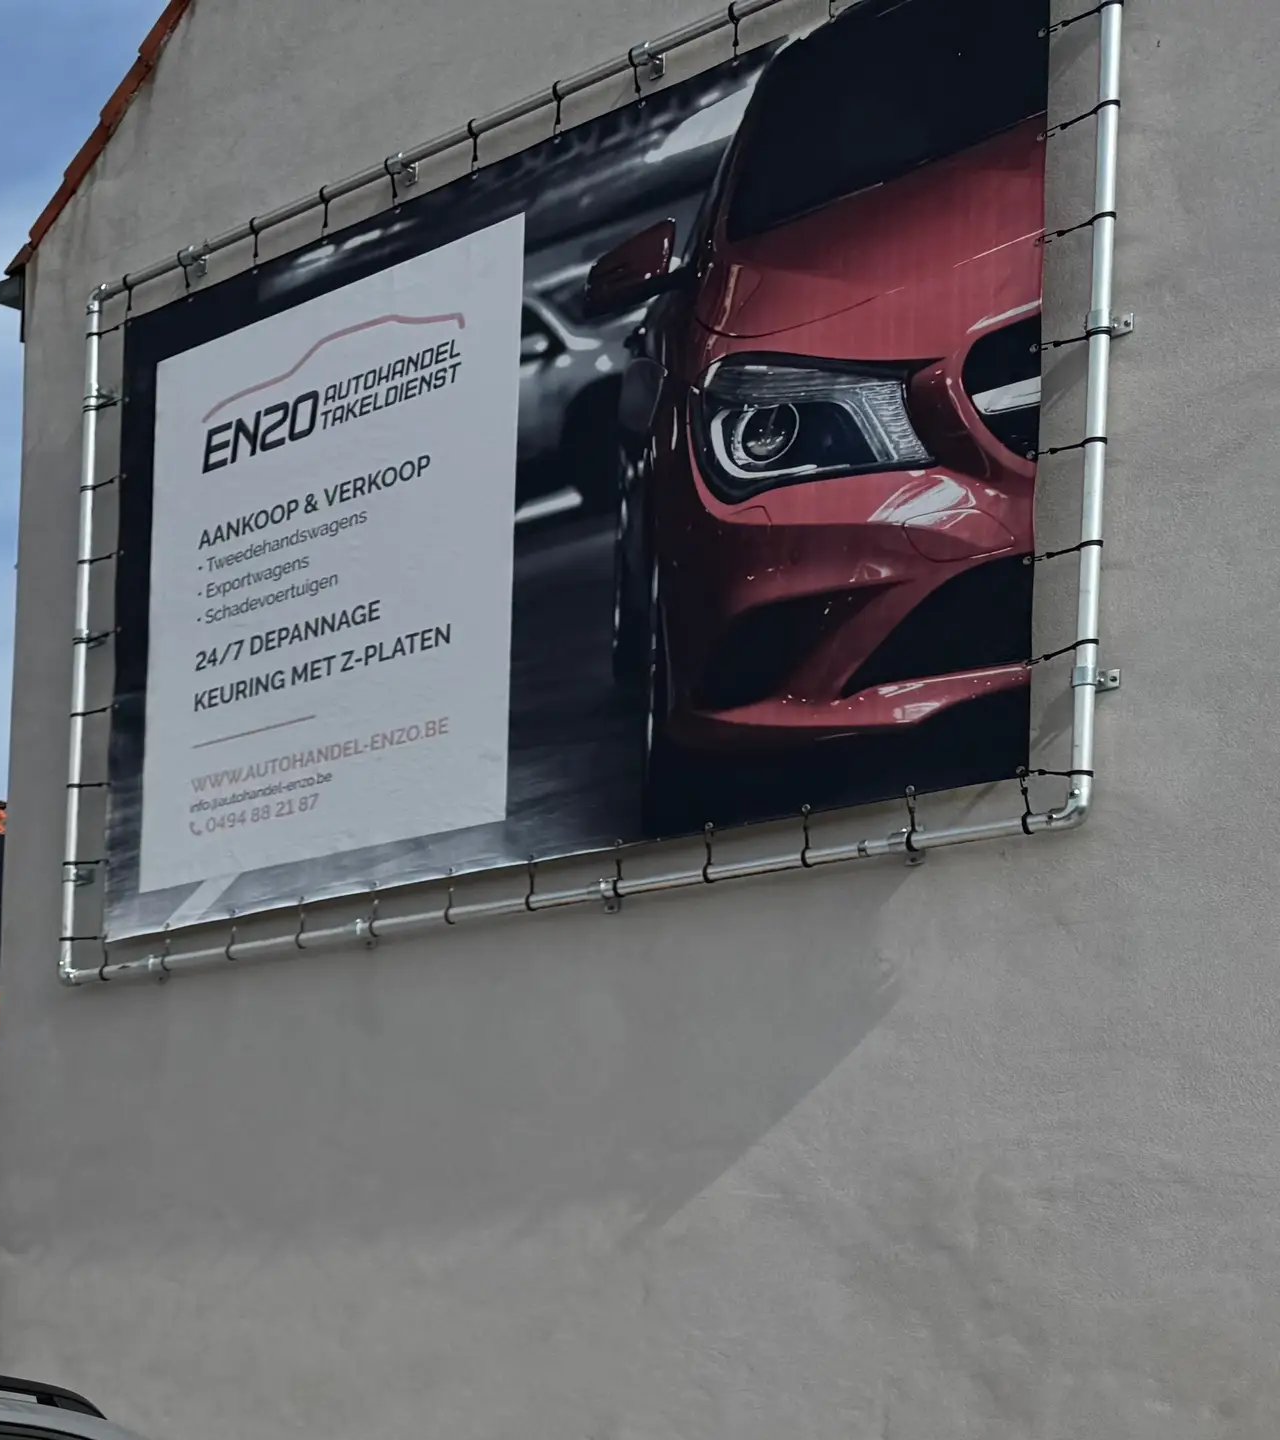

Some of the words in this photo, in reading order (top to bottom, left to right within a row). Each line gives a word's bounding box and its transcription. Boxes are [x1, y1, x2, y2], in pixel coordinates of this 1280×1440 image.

[321, 362, 461, 430] TAKELDIENST
[324, 339, 461, 405] AUTOHANDEL
[198, 499, 299, 550] AANKOOP
[304, 493, 319, 513] &
[324, 455, 431, 506] VERKOOP
[206, 510, 368, 572] Tweedehandswagens
[205, 573, 338, 625] Schadevoertuigen
[206, 555, 310, 598] Exportwagens
[194, 670, 285, 712] KEURING
[291, 656, 335, 688] MET
[340, 624, 452, 672] Z-PLATEN
[195, 639, 243, 671] 24/7
[250, 600, 381, 656] DEPANNAGE
[191, 717, 449, 793] WWW.AUTOHANDEL-ENZO.BE
[206, 809, 246, 832] 0494
[275, 799, 294, 818] 21
[299, 793, 319, 811] 87
